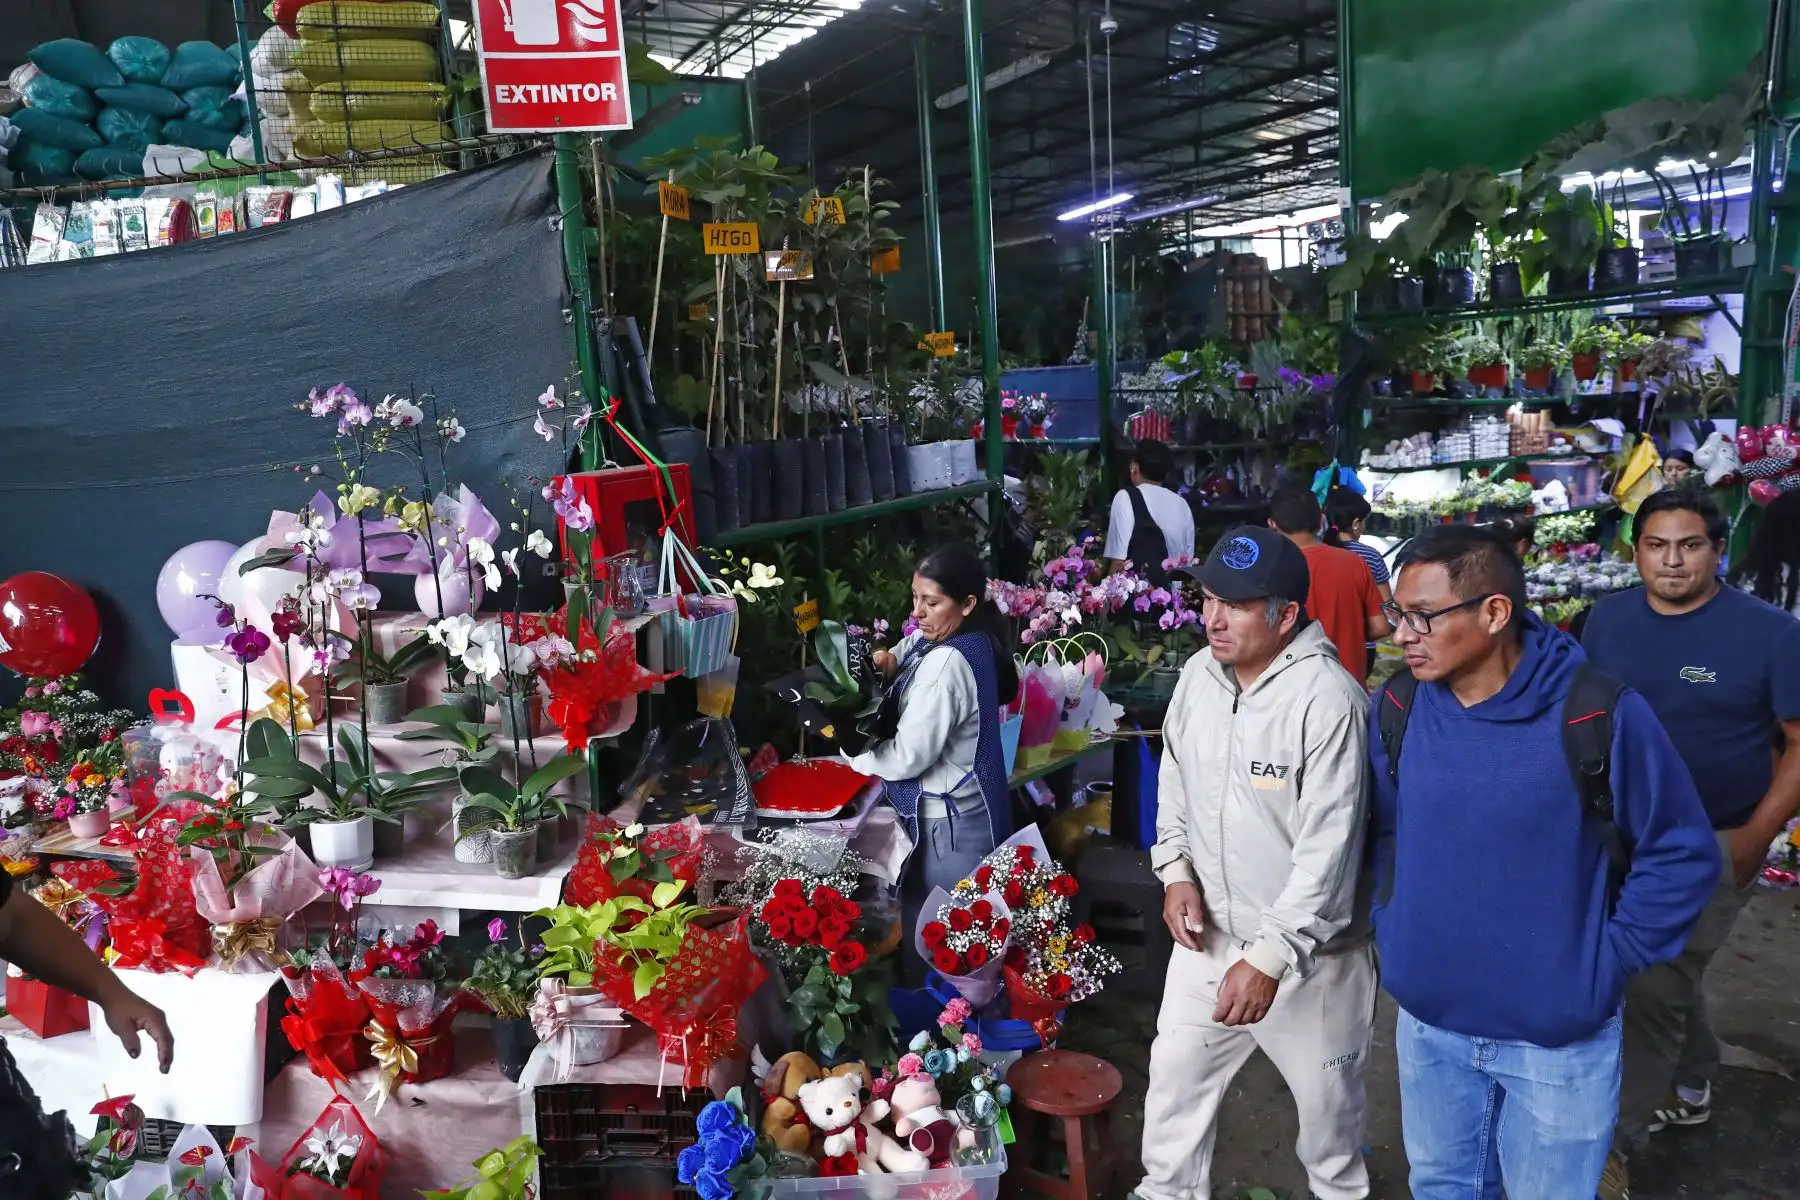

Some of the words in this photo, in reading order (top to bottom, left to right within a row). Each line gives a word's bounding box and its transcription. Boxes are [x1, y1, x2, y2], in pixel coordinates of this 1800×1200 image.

[495, 83, 617, 104] EXTINTOR
[663, 187, 686, 214] MORA
[710, 230, 752, 247] HIGO
[1250, 760, 1290, 780] EA7
